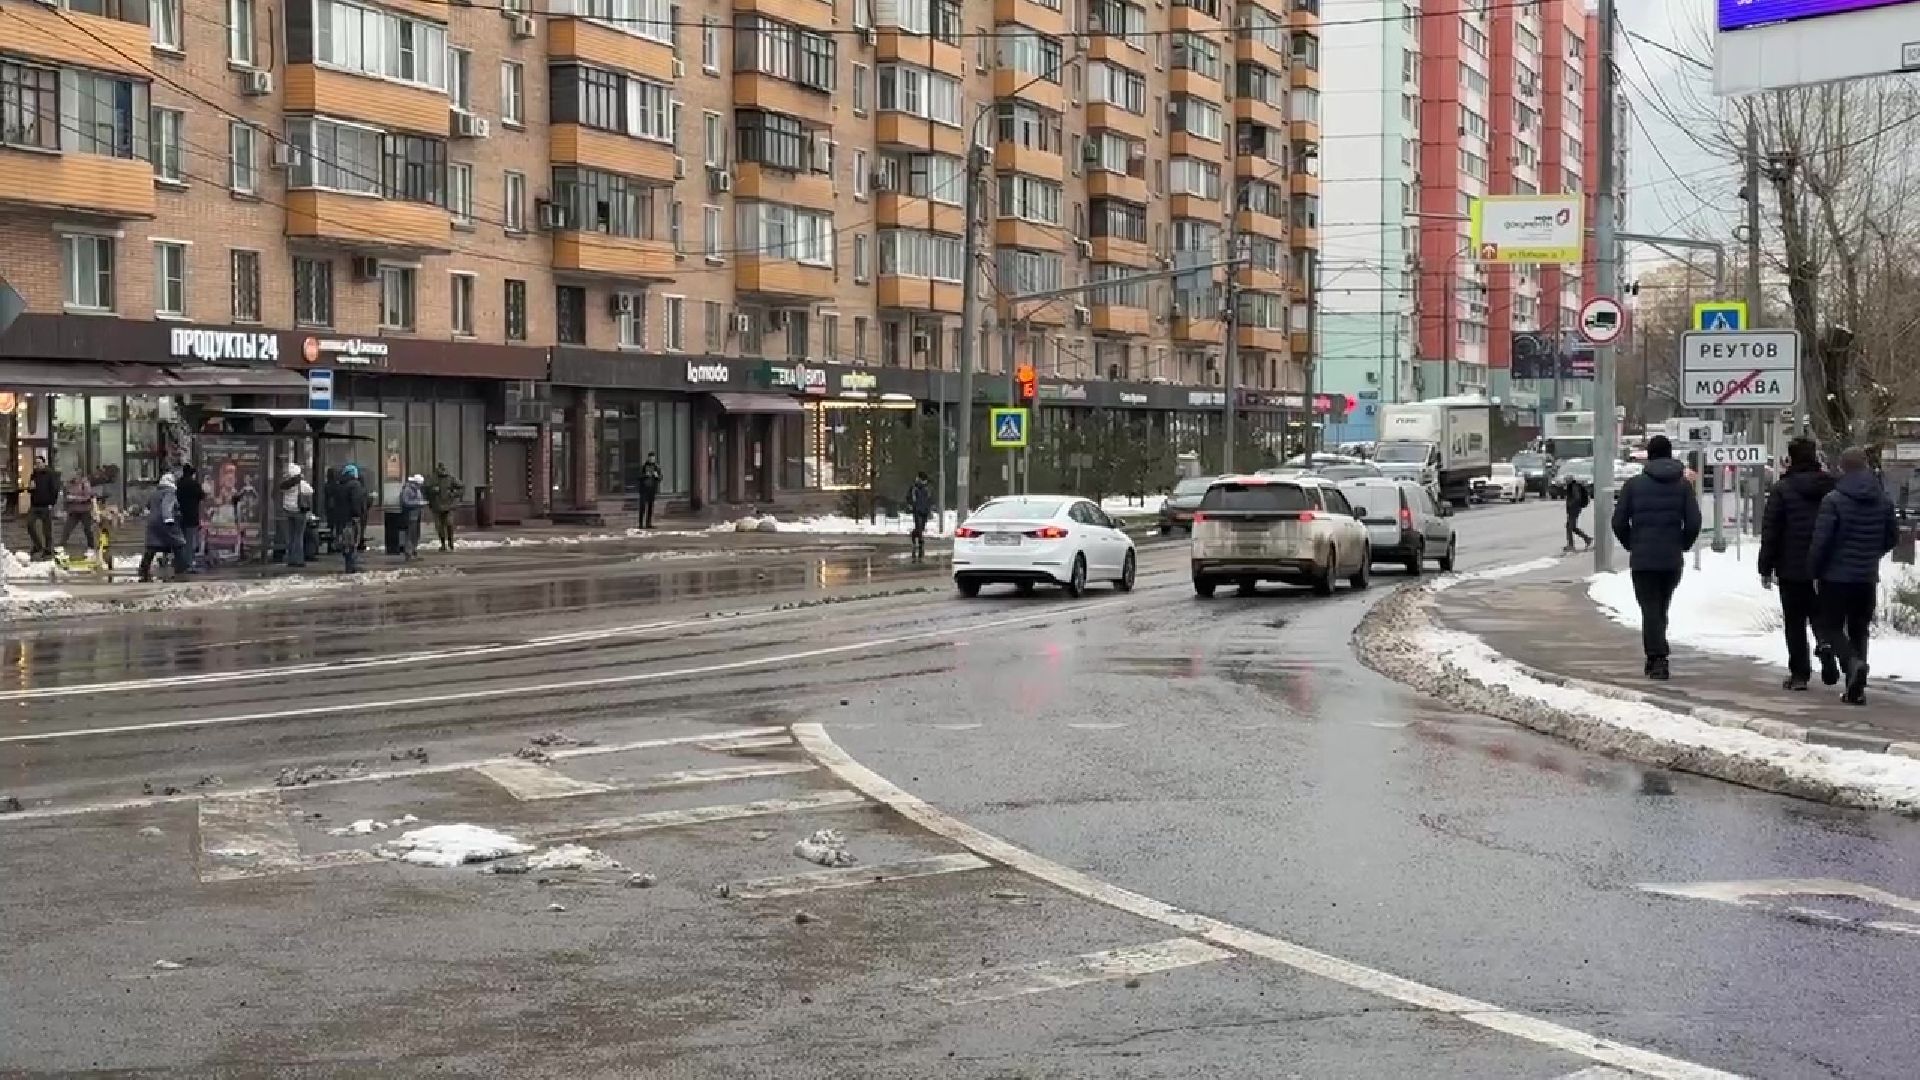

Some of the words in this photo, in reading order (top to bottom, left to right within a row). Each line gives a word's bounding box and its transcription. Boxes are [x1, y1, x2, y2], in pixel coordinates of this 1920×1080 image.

[171, 328, 256, 361] ПРОДУКТЫ
[258, 333, 279, 361] 24
[1700, 342, 1778, 358] РЕУТОВ
[1696, 380, 1780, 394] МОСКВА
[1714, 447, 1759, 461] СТОП
